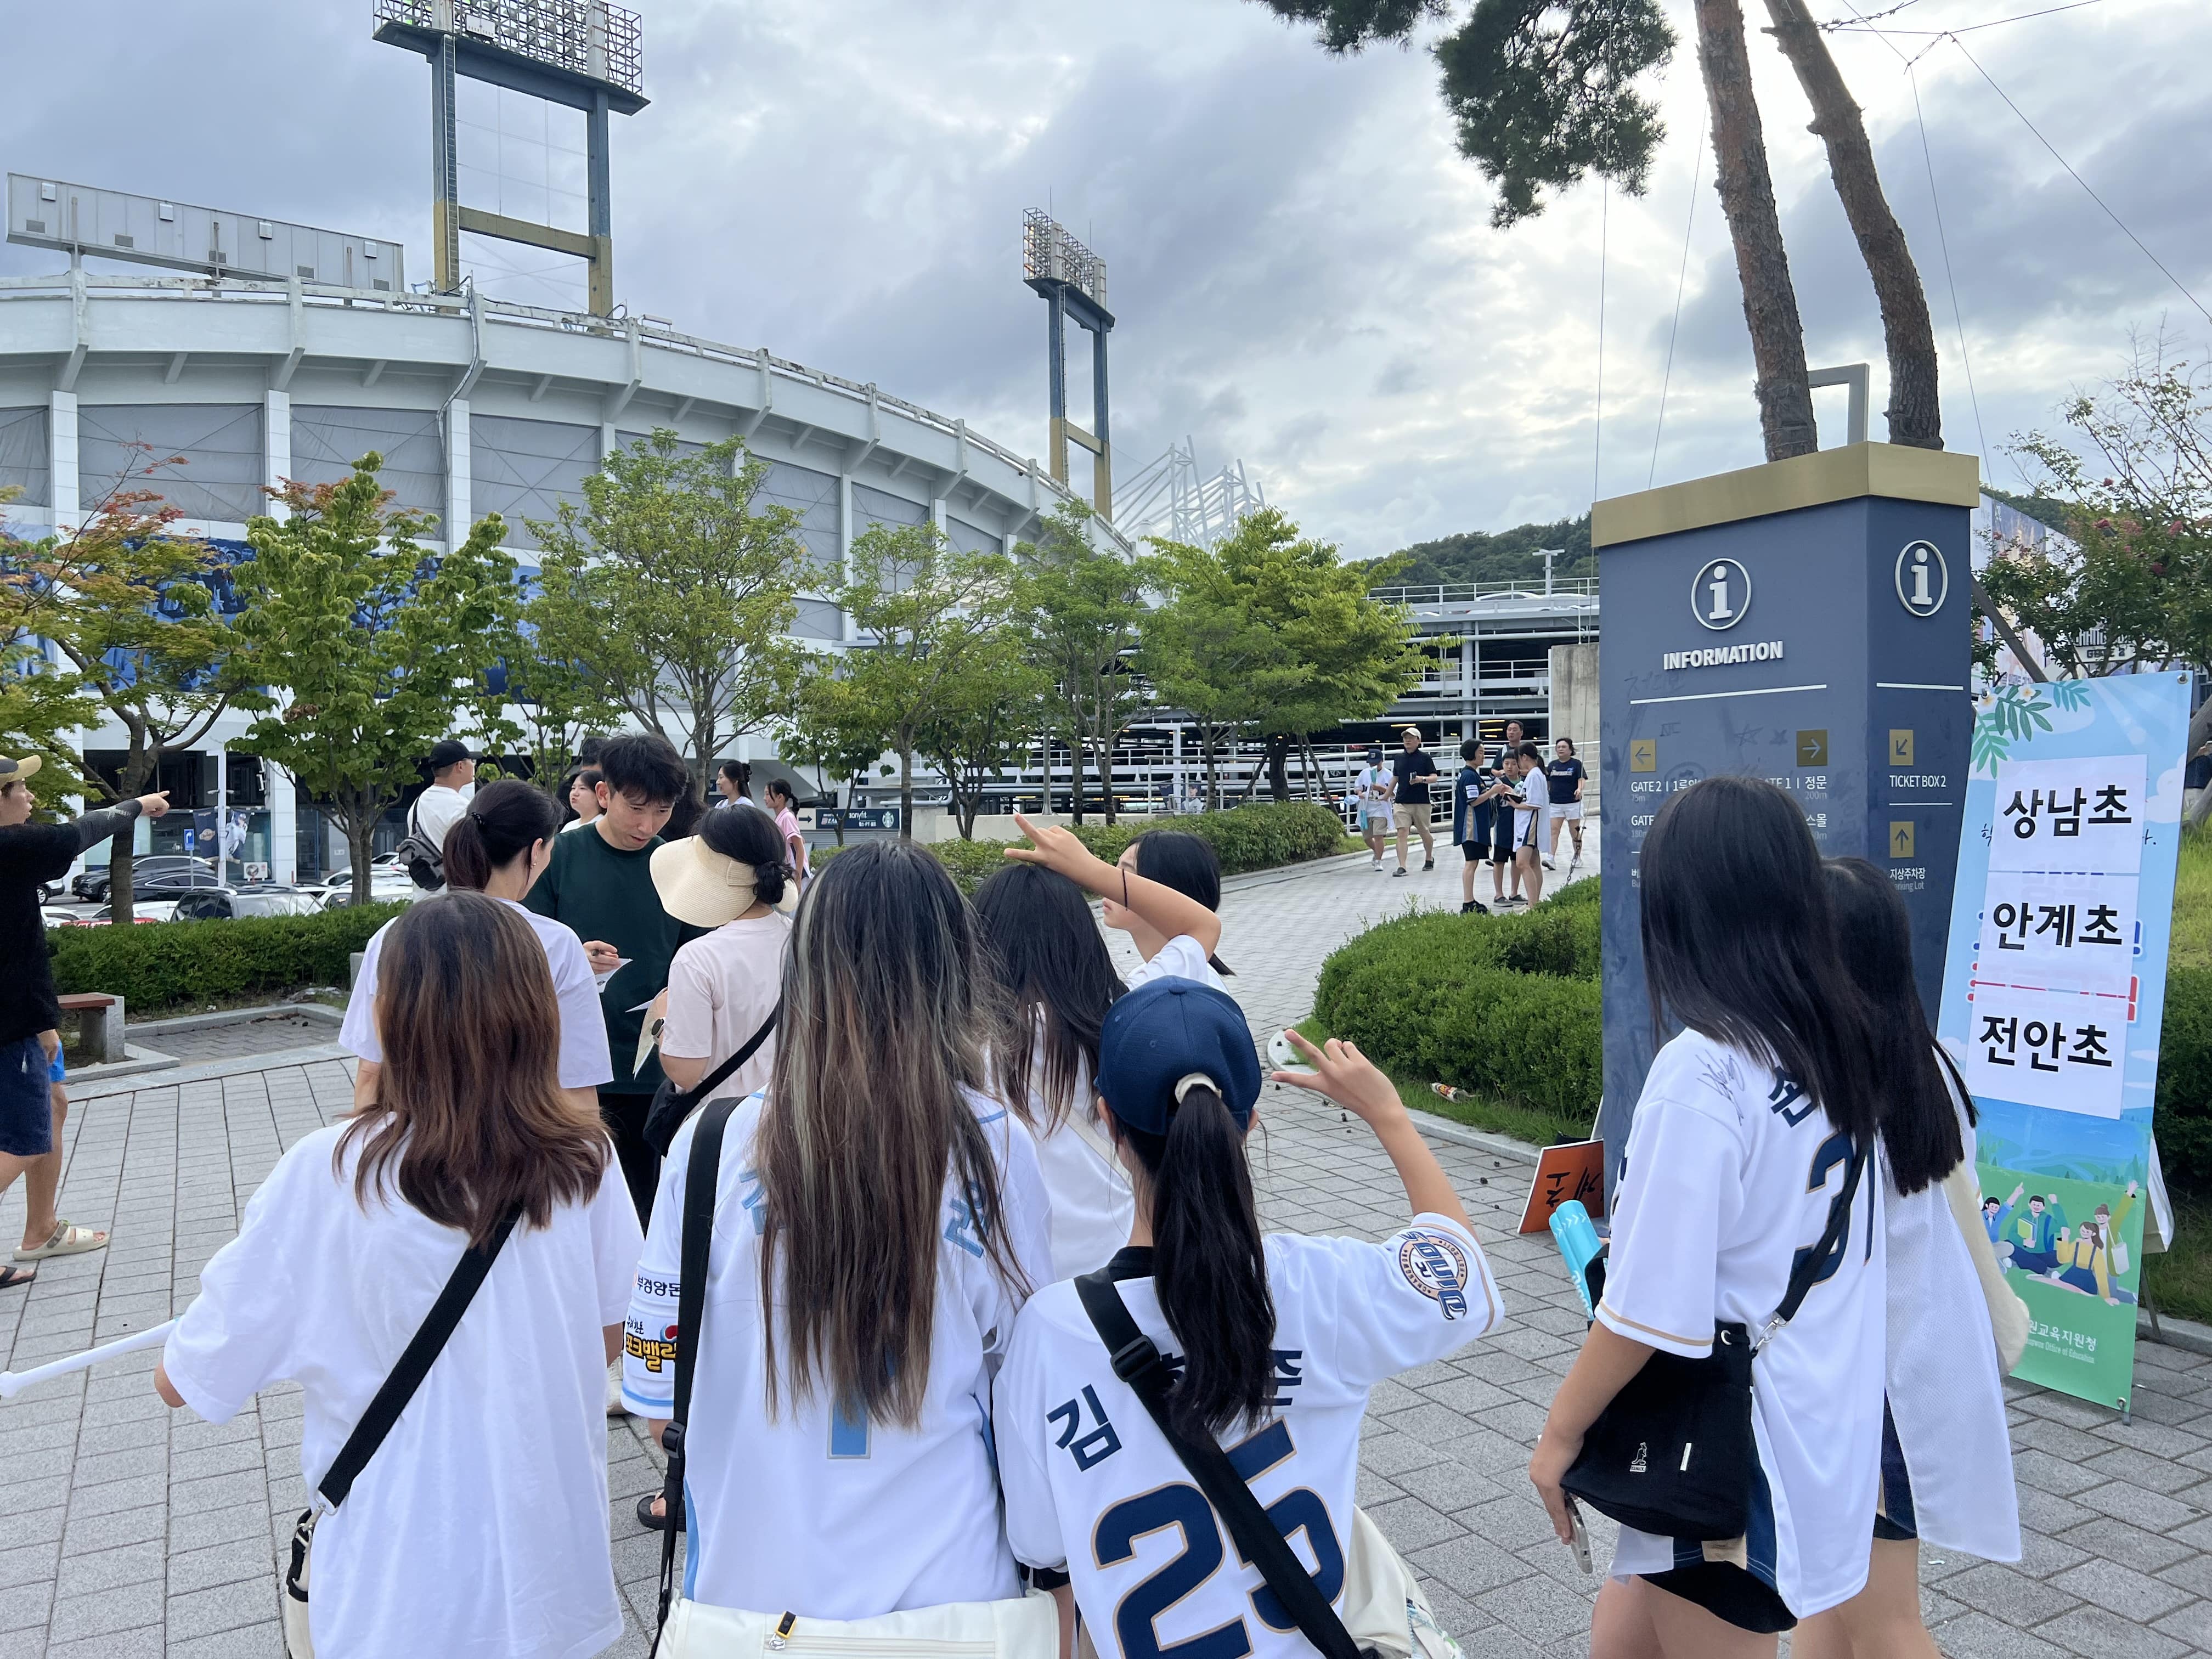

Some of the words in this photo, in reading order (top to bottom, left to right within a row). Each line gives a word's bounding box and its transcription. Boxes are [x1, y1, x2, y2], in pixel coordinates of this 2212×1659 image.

[1663, 641, 1784, 670] INFORMATION
[1631, 781, 1655, 792] GATE
[1656, 781, 1662, 792] 2
[1785, 777, 1791, 789] 1
[1805, 775, 1827, 789] 정문
[1889, 775, 1920, 787] TICKET
[1922, 775, 1939, 787] BOX
[1940, 775, 1946, 787] 2
[1631, 794, 1646, 803] 75m
[1805, 791, 1827, 800] 200m
[2004, 785, 2132, 839] 상남초
[1805, 813, 1827, 827] 스몰
[1631, 868, 1641, 878] 버
[1889, 867, 1926, 881] 지상주차장
[1894, 881, 1914, 893] arking
[1914, 881, 1925, 890] Lot
[1993, 902, 2123, 951] 안계초
[1979, 1015, 2113, 1072] 전안초
[2029, 1319, 2096, 1352] 원교육지원청
[1090, 1415, 1347, 1659] 25
